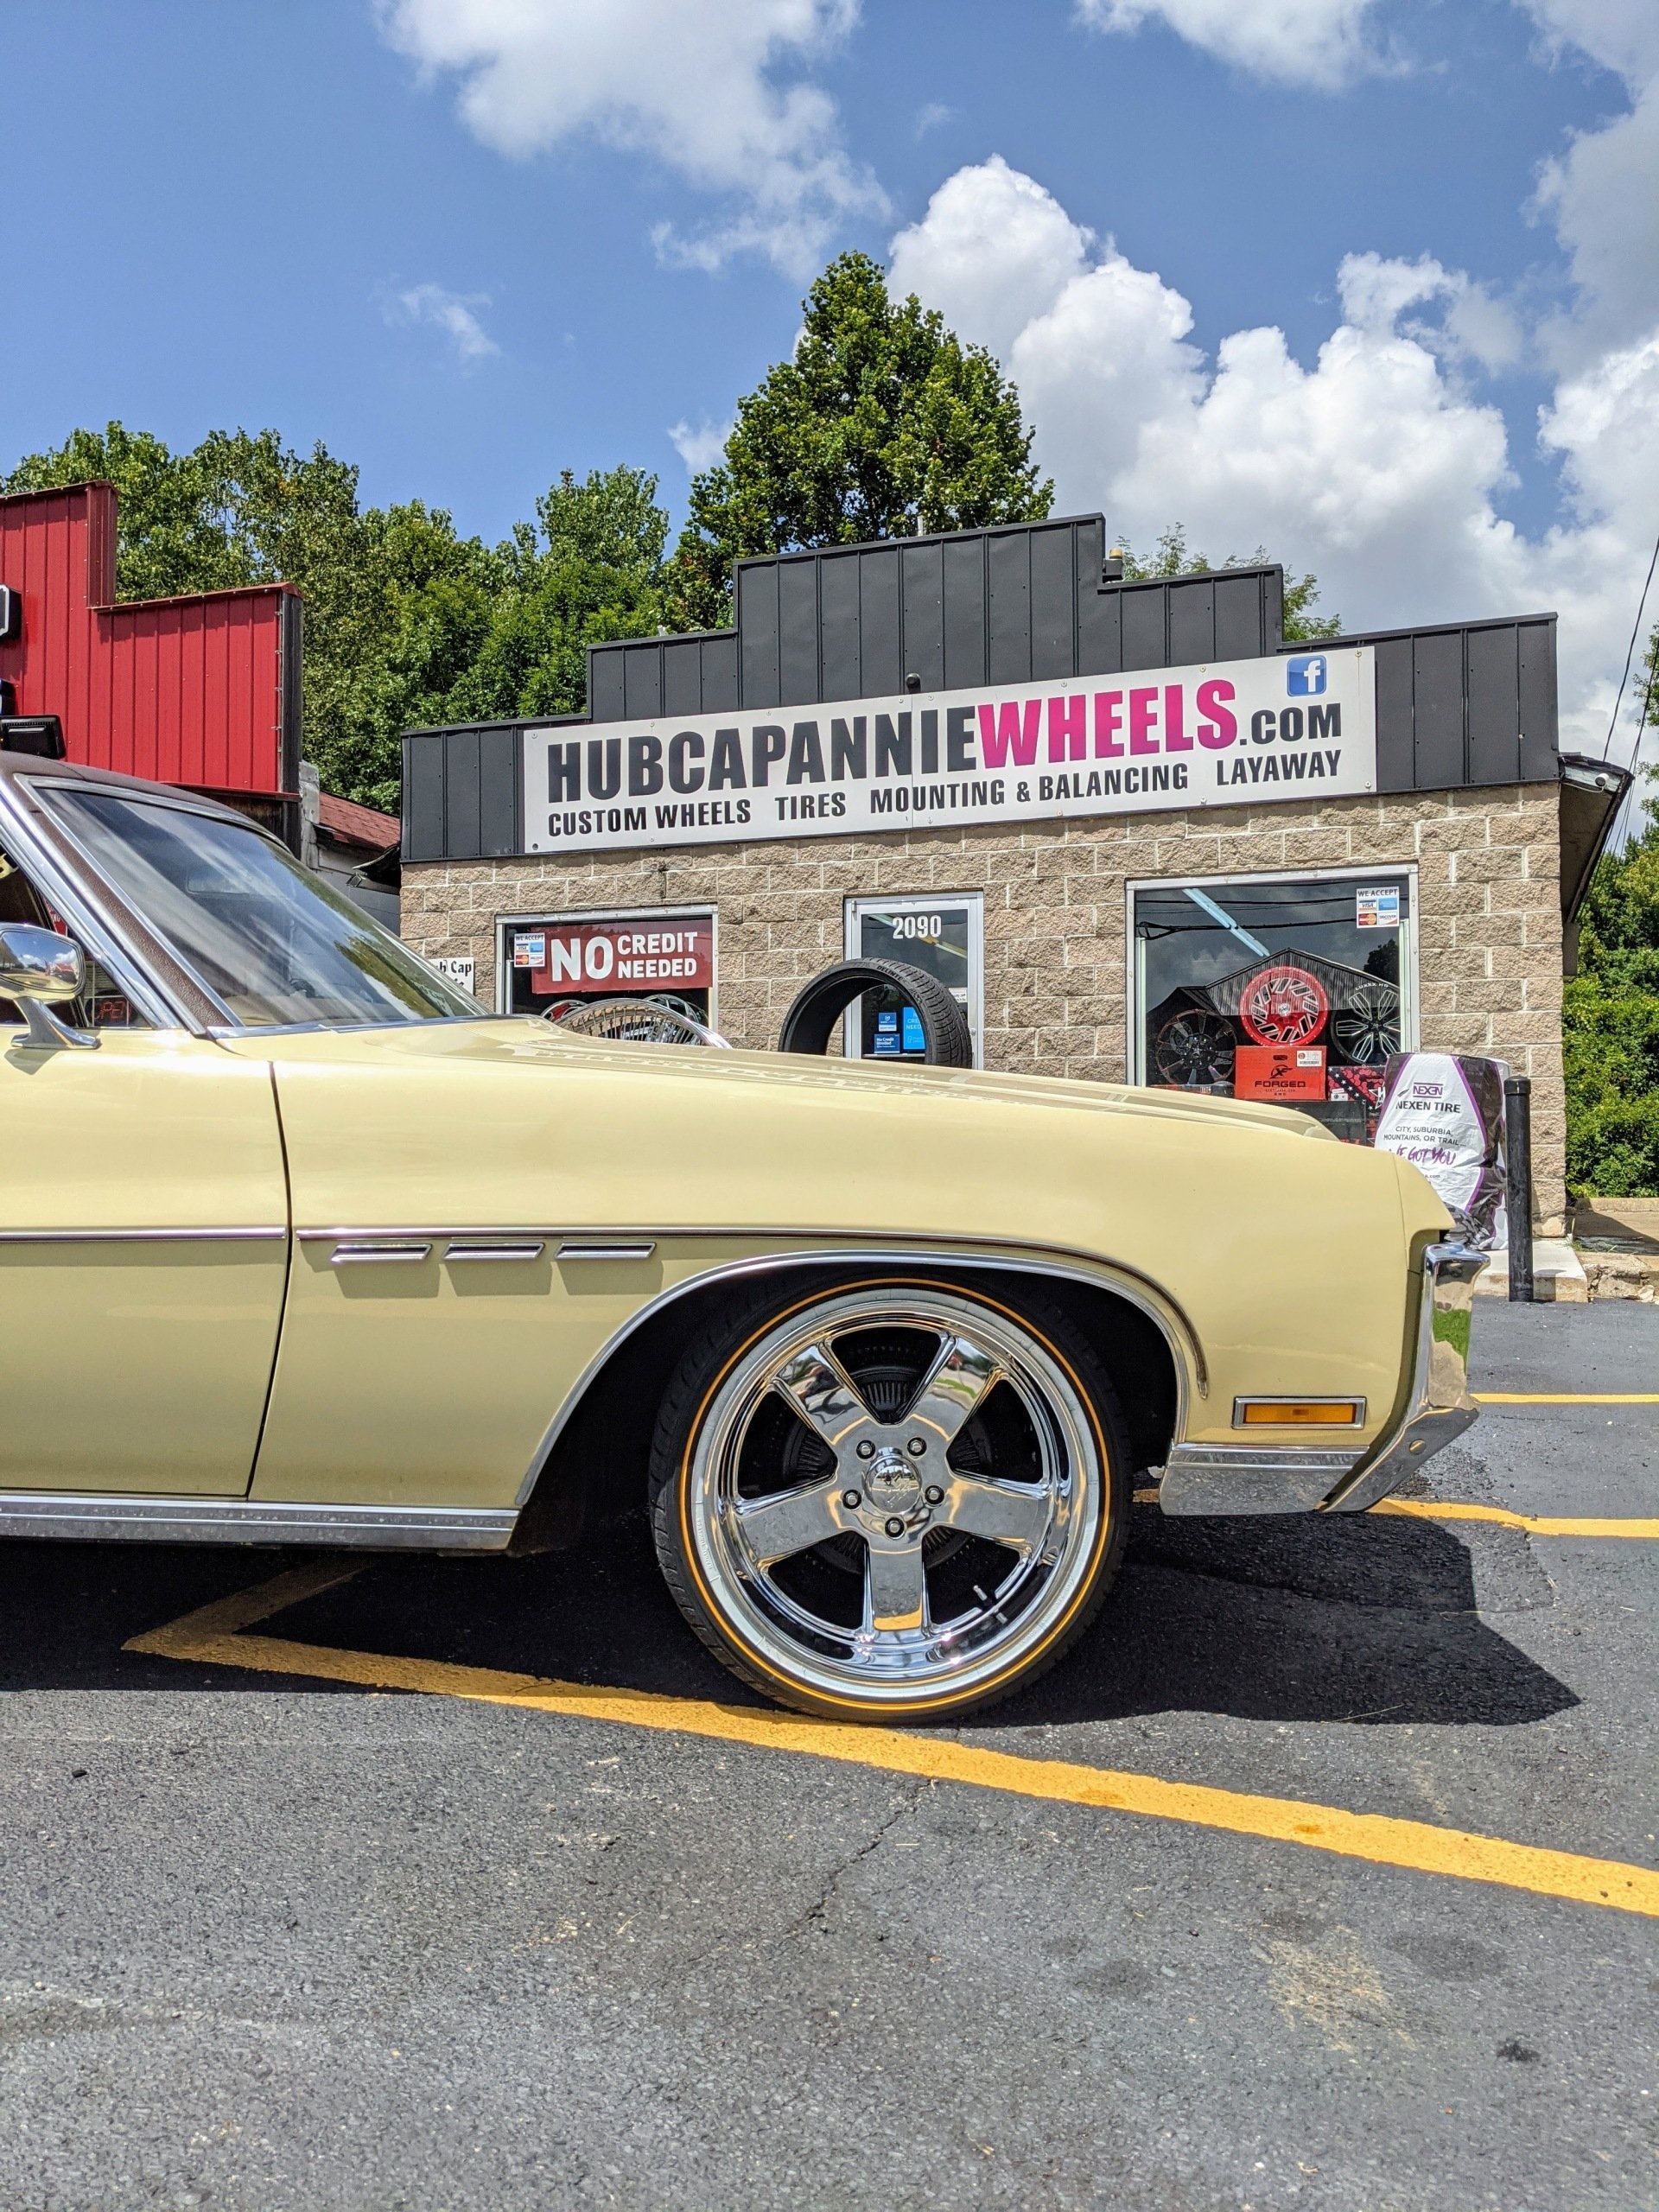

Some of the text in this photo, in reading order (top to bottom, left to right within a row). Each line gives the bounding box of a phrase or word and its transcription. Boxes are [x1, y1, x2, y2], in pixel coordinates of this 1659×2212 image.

[548, 679, 1342, 804] HUBCAPANNIEWHEELS.COM
[548, 749, 1342, 837] CUSTOM WHEELS TIRES MOUNTING & BALANCING LAYAWAY
[892, 914, 942, 939] 2090
[550, 931, 698, 982] NO CREDIT
[451, 960, 472, 976] Cap
[617, 957, 697, 979] NEEDED
[1413, 1085, 1443, 1096] NEXEN
[1395, 1101, 1461, 1114] NEXEN TIRE
[1413, 1126, 1453, 1137] SUBURBIA,
